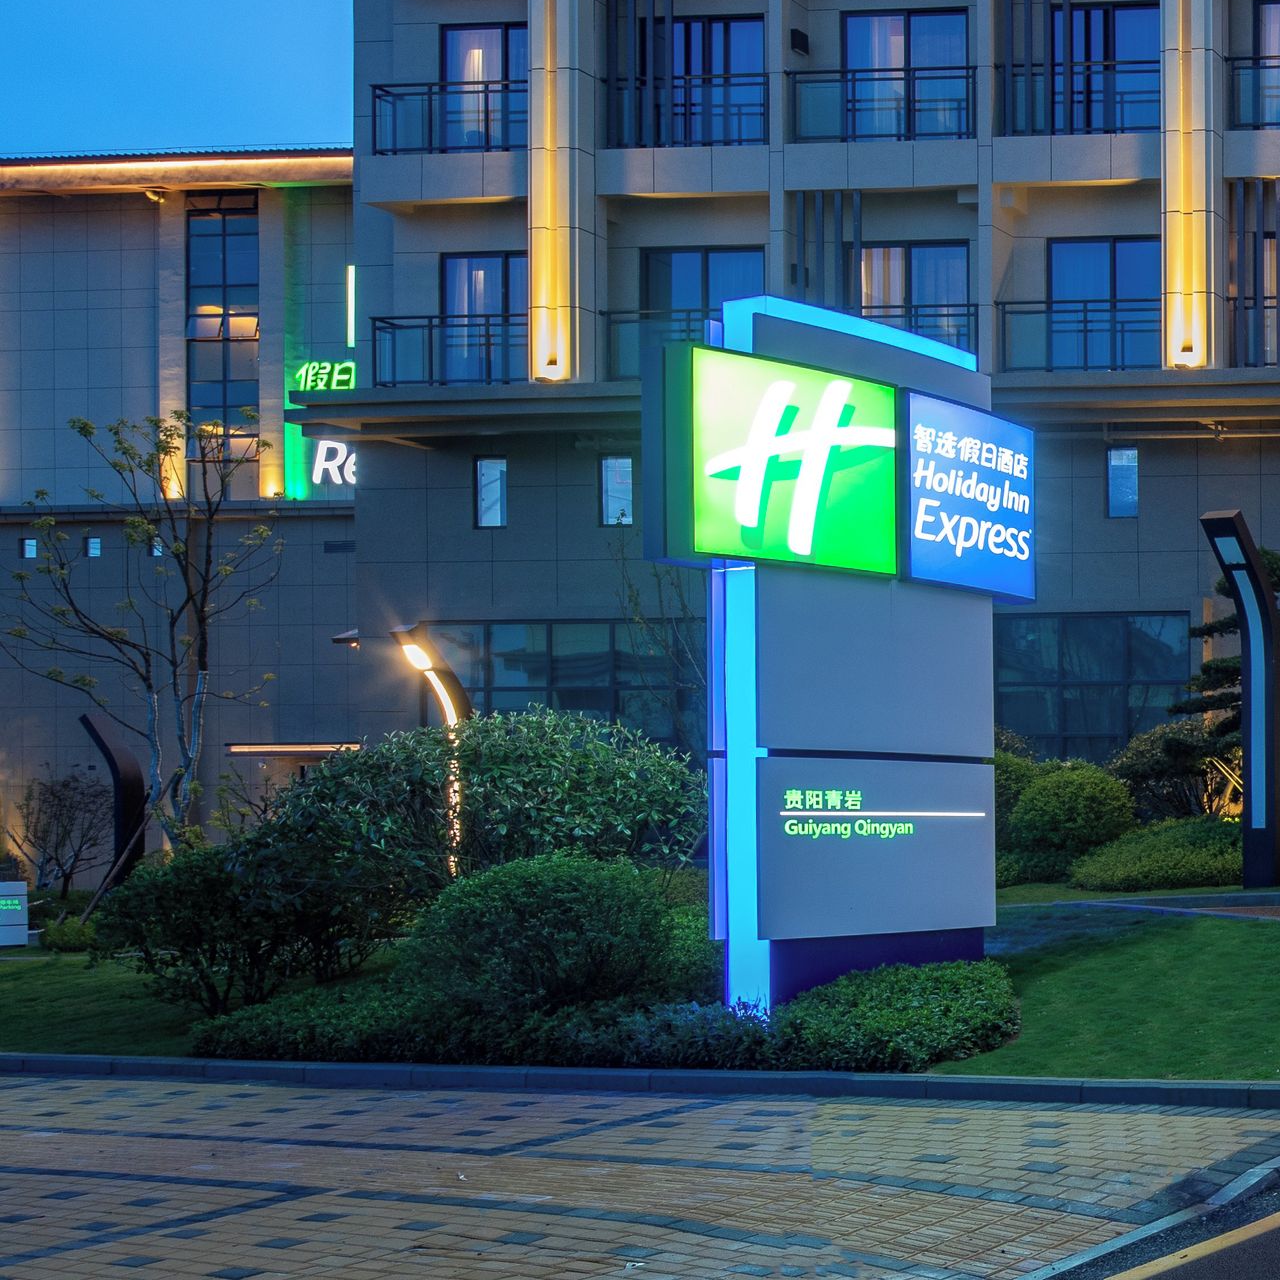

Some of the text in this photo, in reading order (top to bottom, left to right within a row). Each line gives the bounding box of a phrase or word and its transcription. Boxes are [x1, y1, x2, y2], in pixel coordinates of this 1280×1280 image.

[913, 424, 1029, 480] 智选假日酒店
[913, 458, 1030, 514] Holiday Inn
[914, 497, 1030, 561] Express
[784, 789, 862, 810] 贵阳青岩
[784, 820, 914, 839] Guiyang Qingyan
